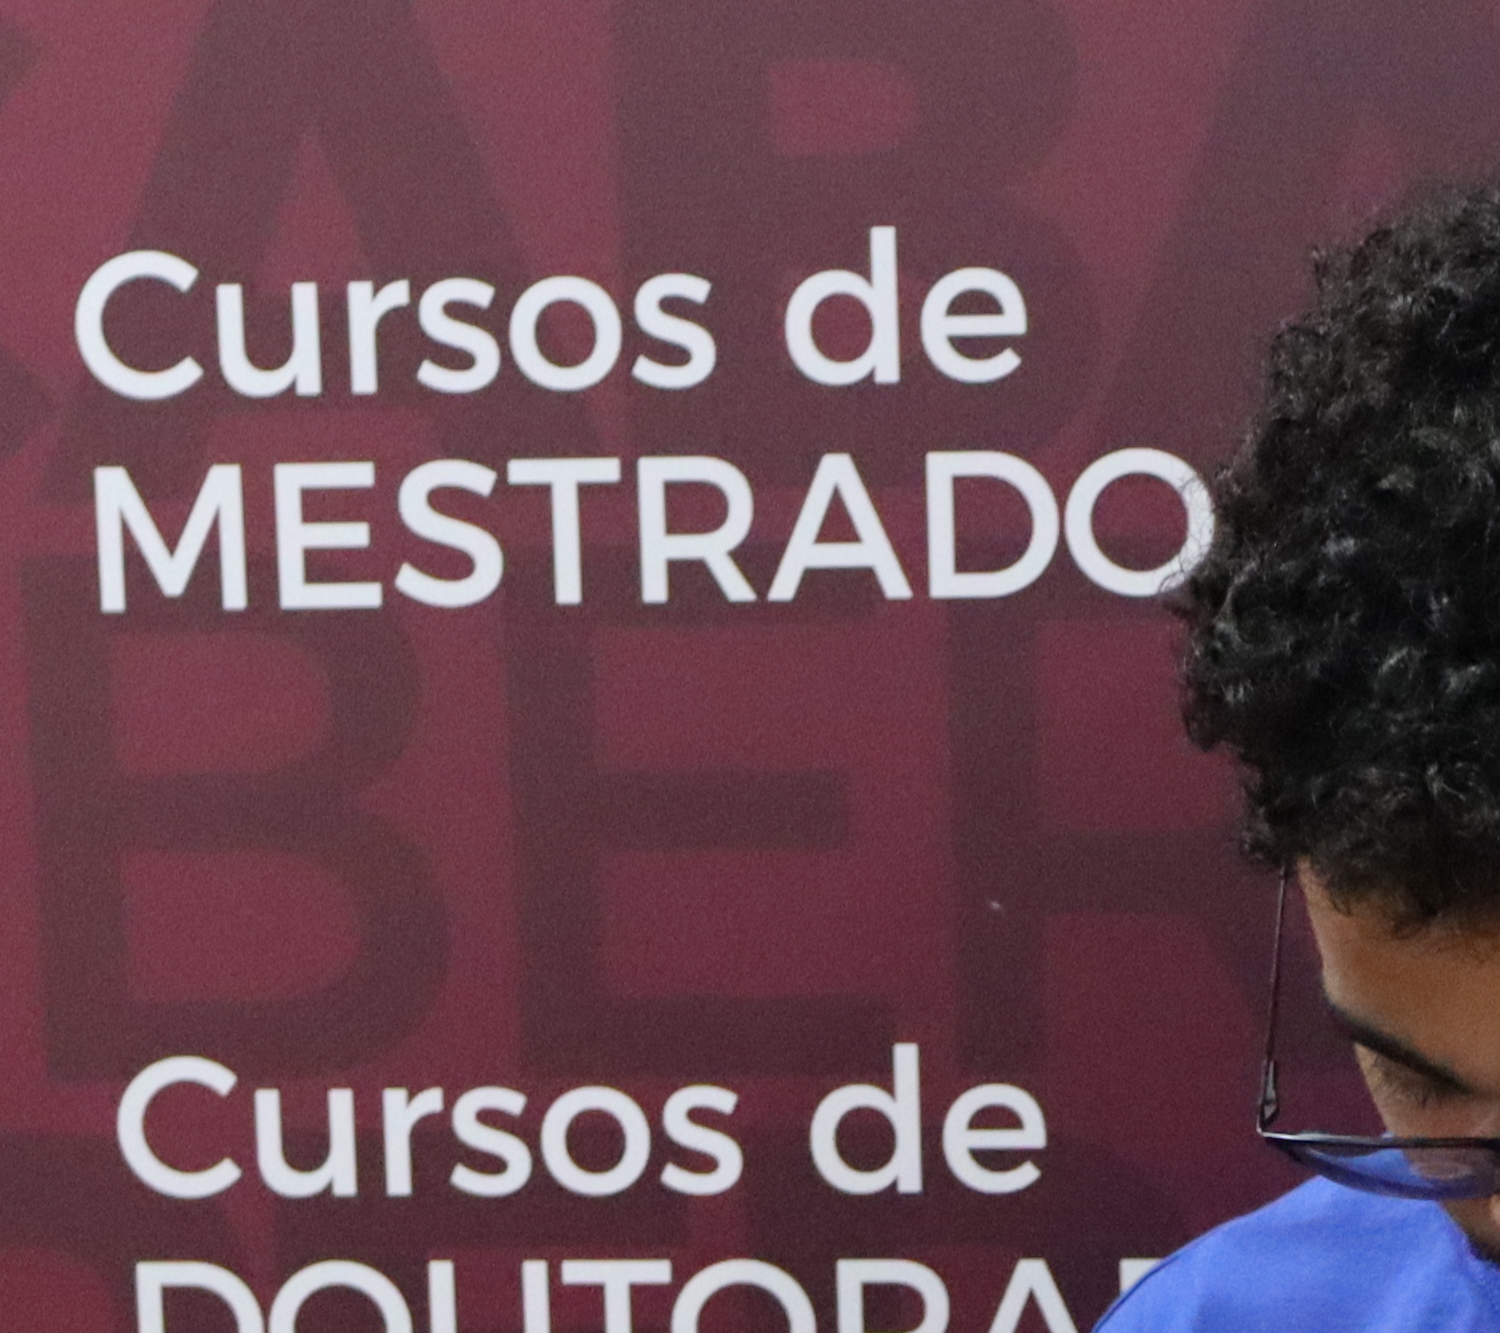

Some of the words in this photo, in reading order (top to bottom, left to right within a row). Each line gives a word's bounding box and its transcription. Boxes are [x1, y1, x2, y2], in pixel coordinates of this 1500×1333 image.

[75, 250, 716, 400] Cursos
[784, 226, 1028, 386] de
[93, 447, 1220, 614] MESTRADO
[117, 1056, 743, 1199] Cursos
[810, 1043, 1046, 1194] de
